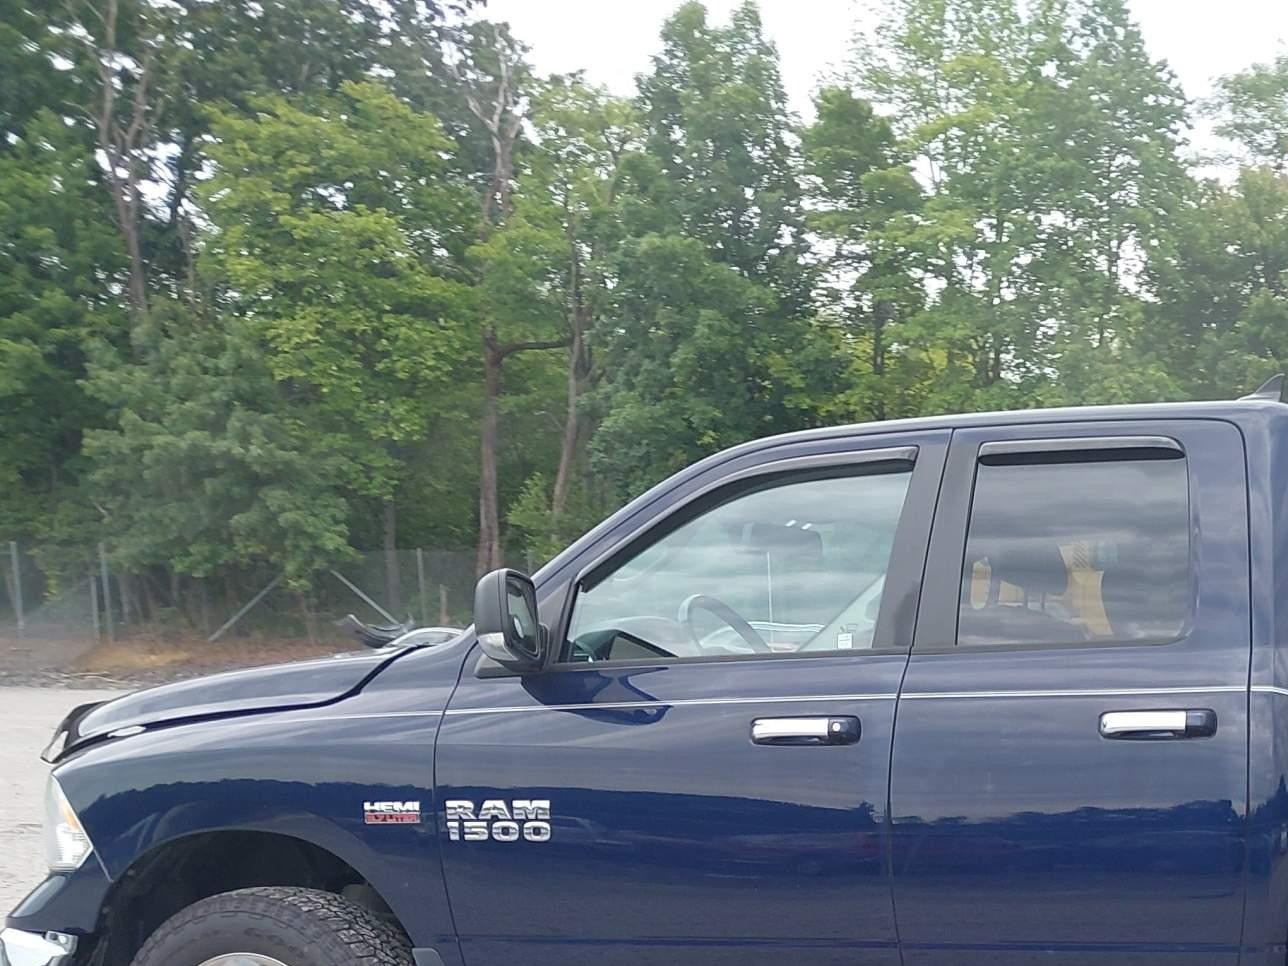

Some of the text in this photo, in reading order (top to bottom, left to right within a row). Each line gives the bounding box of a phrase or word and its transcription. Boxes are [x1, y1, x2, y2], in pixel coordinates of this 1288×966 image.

[363, 800, 420, 812] HEMI
[445, 799, 551, 820] RAM
[447, 821, 552, 842] 1500
